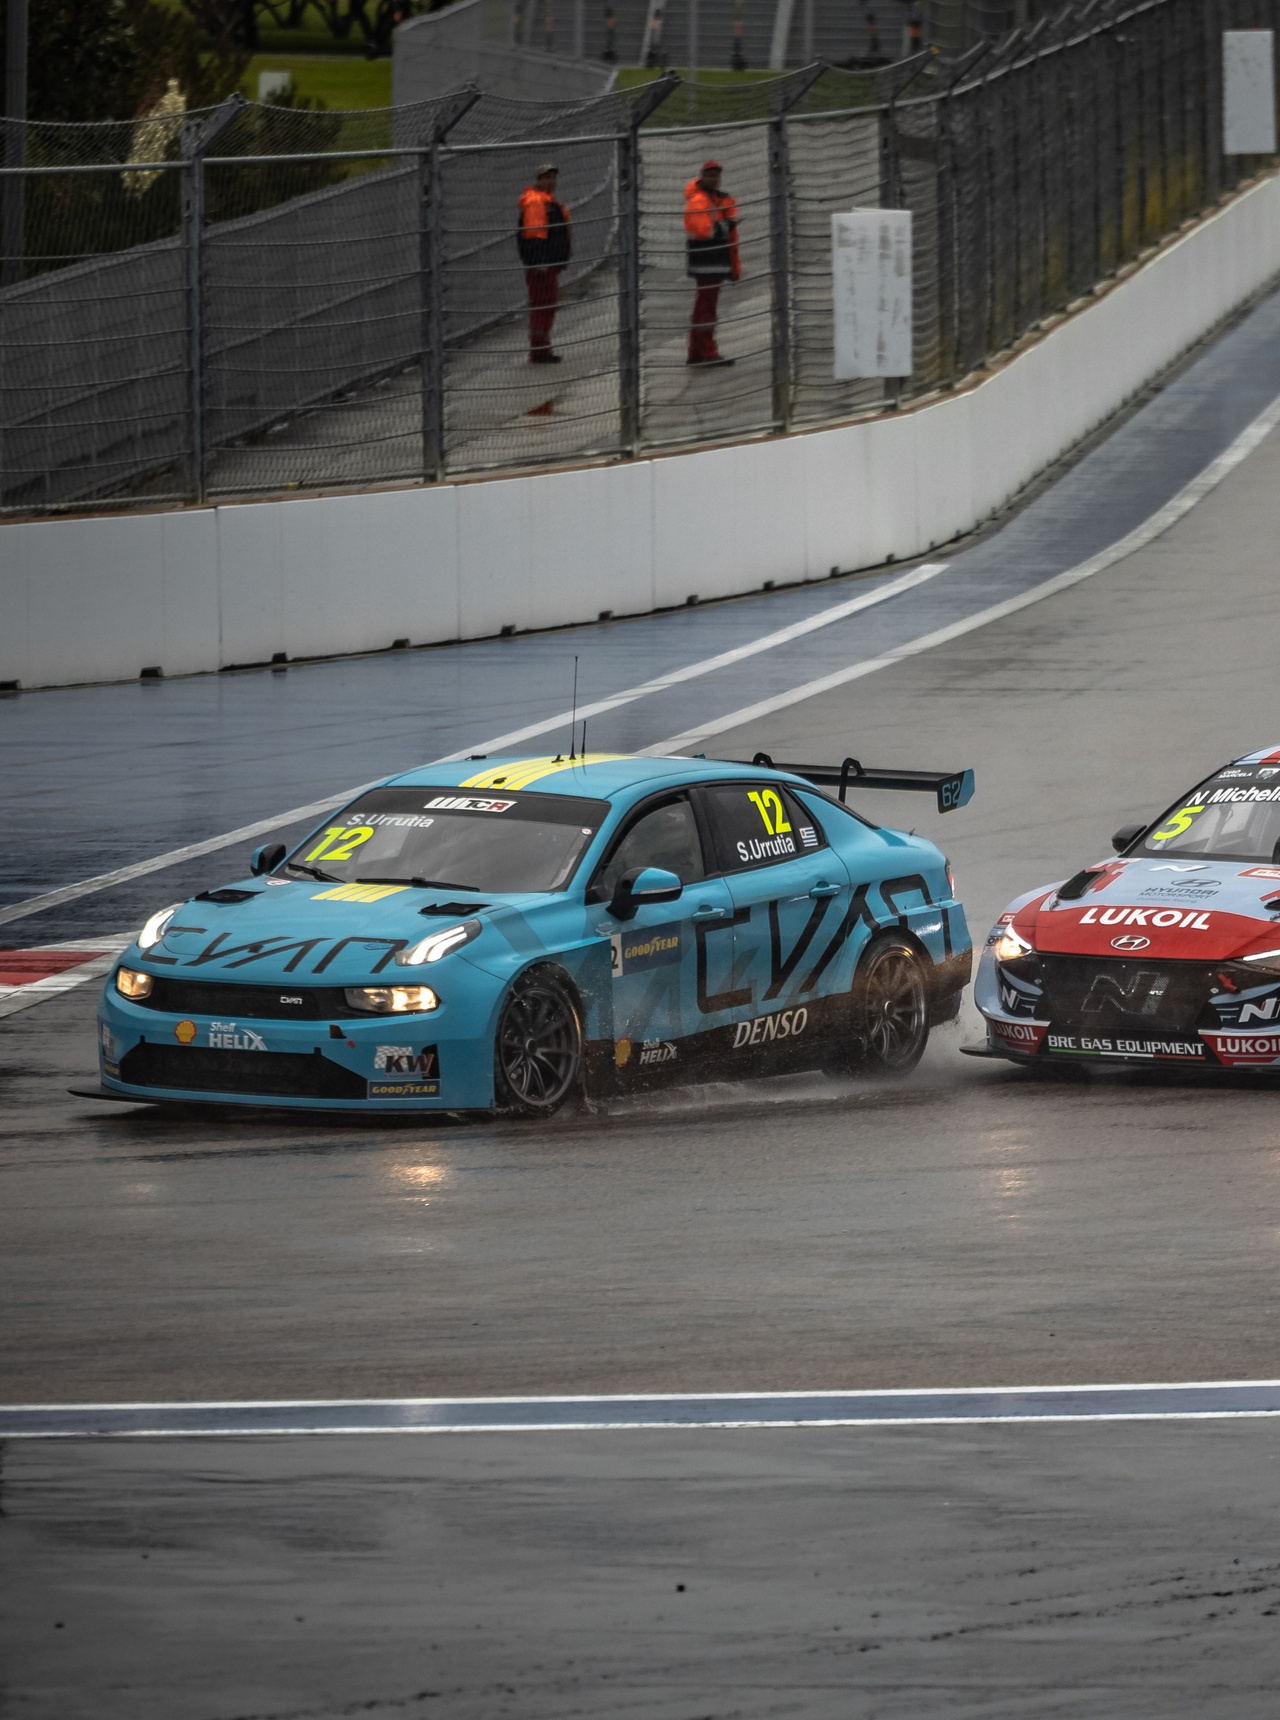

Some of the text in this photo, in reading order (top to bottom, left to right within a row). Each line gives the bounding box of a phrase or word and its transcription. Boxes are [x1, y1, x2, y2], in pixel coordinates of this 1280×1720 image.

[347, 814, 435, 828] S.Urrutia
[748, 789, 792, 835] 12
[1152, 806, 1205, 840] 5
[304, 826, 374, 862] 12
[737, 834, 796, 862] S.Urrutia
[1144, 887, 1220, 895] HYUNDAI
[1079, 908, 1211, 931] LUKOIL
[624, 935, 679, 959] GOODYEAR
[210, 1022, 236, 1033] Shell
[732, 1007, 808, 1049] DENSO
[209, 1032, 262, 1050] HELIX
[1048, 1035, 1204, 1056] BRC GAS EQUIPMENT
[385, 1054, 434, 1073] KW
[639, 1047, 678, 1065] HELIX
[372, 1084, 437, 1095] GOODYEAR
